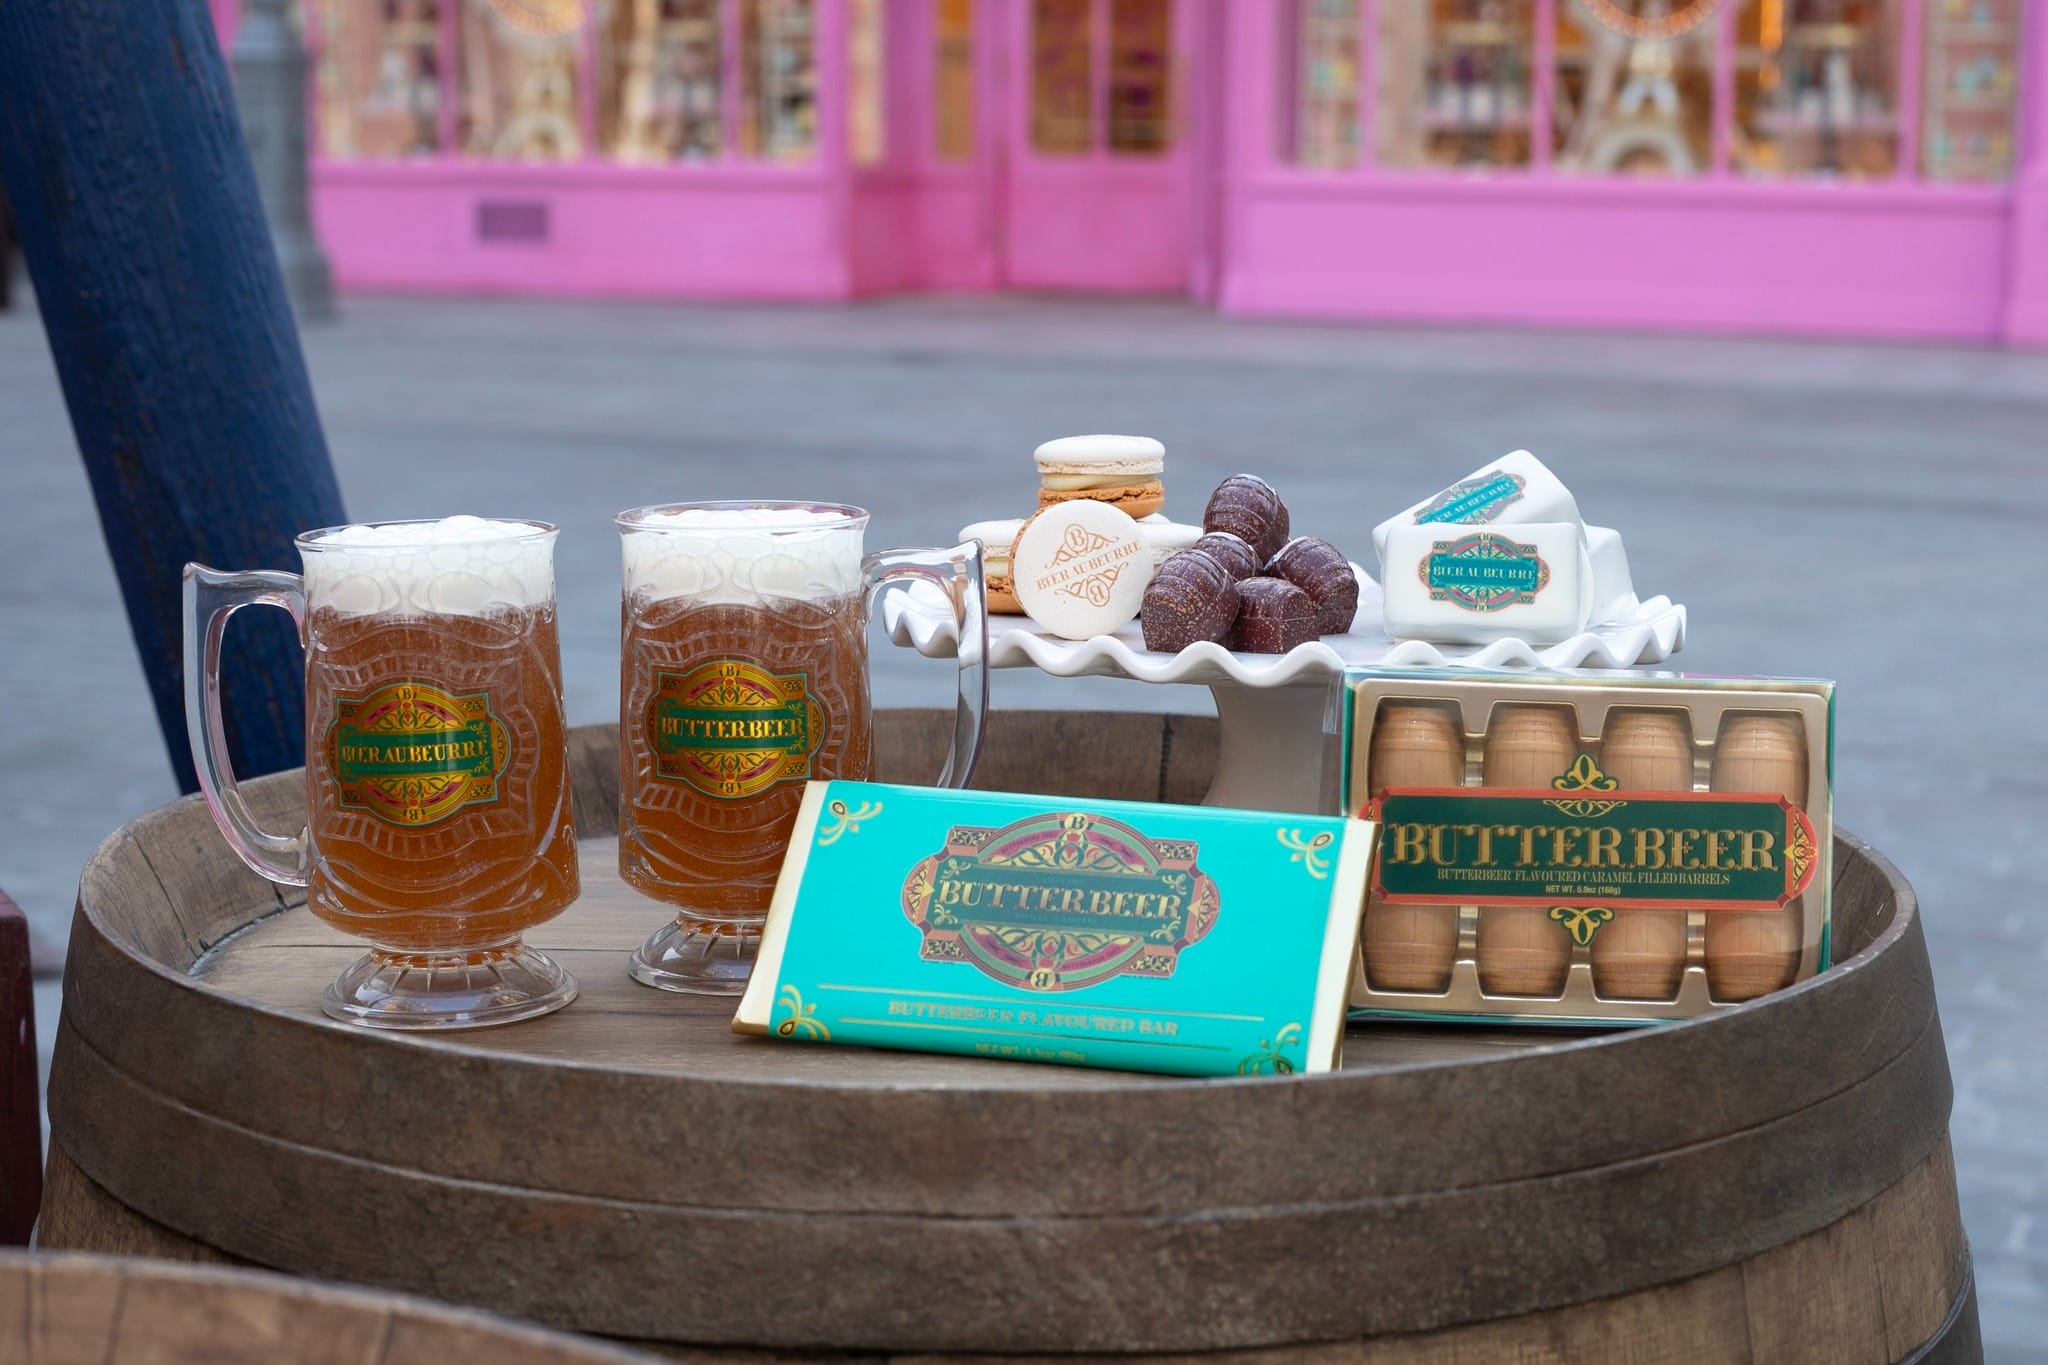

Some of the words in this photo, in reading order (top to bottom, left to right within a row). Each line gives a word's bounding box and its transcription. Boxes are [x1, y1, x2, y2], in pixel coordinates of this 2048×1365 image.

[1438, 869, 1511, 880] BUTTERBEER
[1515, 870, 1580, 882] FLAVOURED
[1583, 871, 1635, 883] CARAMEL
[1638, 872, 1677, 884] FILLED
[1679, 873, 1730, 885] BARRELS
[1546, 885, 1560, 893] NET
[1562, 885, 1575, 893] WT.
[888, 1000, 1013, 1023] BUTTERBEER
[1019, 1010, 1135, 1032] FLAVOURED
[1139, 1019, 1178, 1036] BAR
